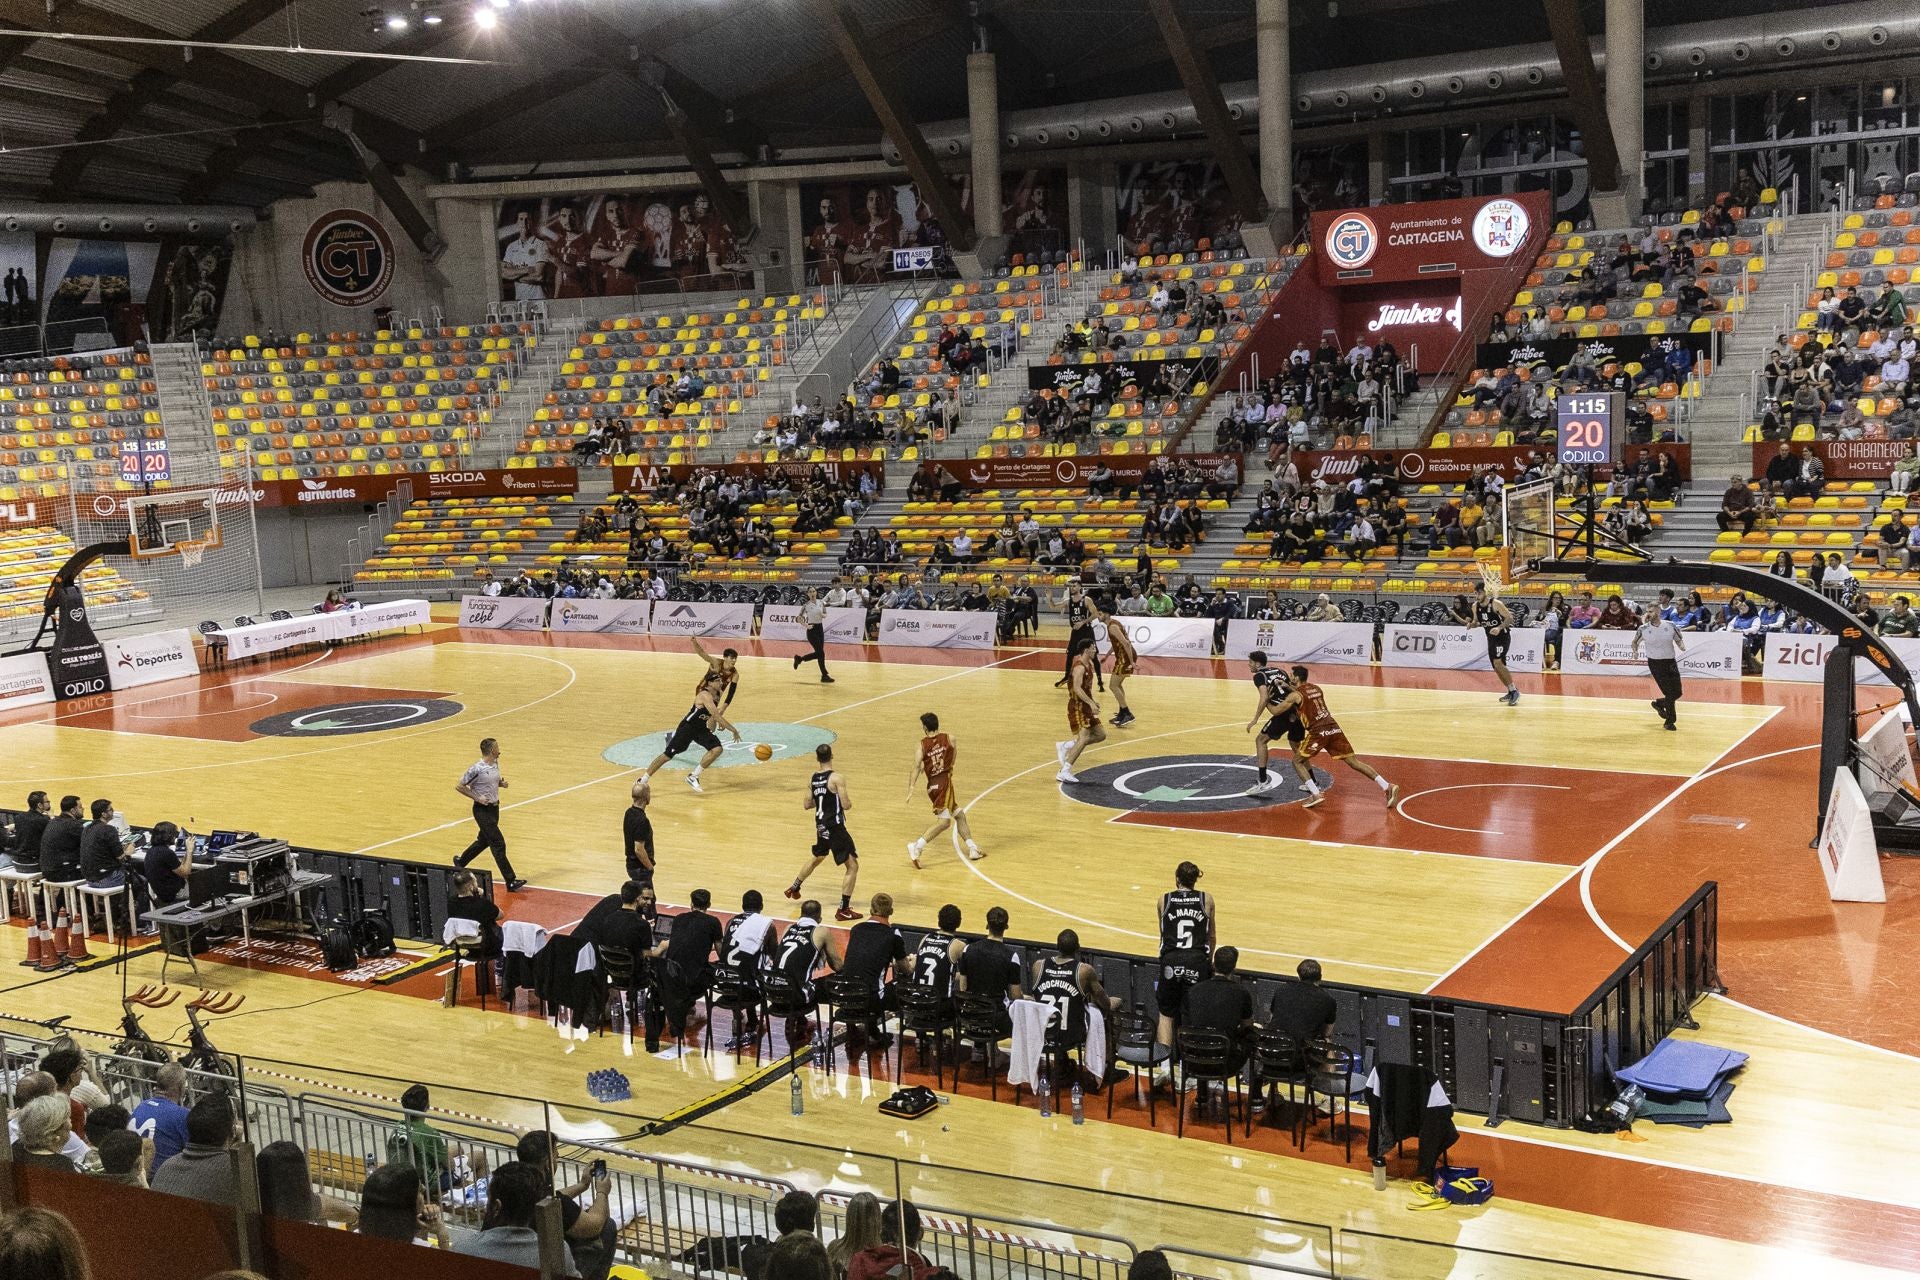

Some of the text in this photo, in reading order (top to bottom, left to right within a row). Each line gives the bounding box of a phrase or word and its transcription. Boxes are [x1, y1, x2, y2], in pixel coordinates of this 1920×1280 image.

[1390, 216, 1462, 231] Ayuntamiento de
[1336, 230, 1367, 252] CT
[1388, 230, 1465, 246] CARTAGENA
[321, 240, 376, 278] CT
[1368, 302, 1442, 332] Jimbee
[1508, 345, 1545, 362] Jimbee
[1569, 399, 1606, 414] 1:15
[1565, 421, 1604, 448] 20
[122, 441, 138, 450] 1:15
[146, 440, 166, 450] 1:15
[1828, 442, 1846, 458] LOS
[145, 454, 166, 471] 20
[1563, 450, 1605, 462] ODILO
[122, 455, 138, 472] 20
[1022, 463, 1051, 472] Cartagena
[1311, 455, 1358, 479] Jimb
[1429, 463, 1459, 471] REGIÓN
[1460, 463, 1471, 471] DE
[1849, 461, 1885, 470] HOTEL
[145, 472, 168, 480] ODILO
[1116, 469, 1143, 477] MURCIA
[203, 487, 265, 508] Jimbee
[298, 488, 356, 502] agriverdes
[563, 609, 599, 620] CARTAGENA
[770, 614, 789, 623] CASA
[617, 619, 629, 627] Palco
[658, 617, 706, 630] inmohogares
[897, 621, 920, 629] CAESA
[283, 628, 307, 640] Cartagena
[830, 629, 843, 637] Palco
[1438, 632, 1473, 642] woods
[1169, 641, 1186, 649] Palco
[1395, 635, 1436, 651] CTD
[1323, 647, 1342, 655] Palco
[135, 651, 183, 668] Deportes
[1511, 654, 1525, 662] VIP
[1684, 660, 1721, 669] Palco VIP
[0, 677, 44, 691] artagena
[65, 679, 104, 697] ODILO
[1168, 908, 1205, 922] A. MARTÍN
[1176, 919, 1195, 949] 5
[779, 941, 798, 969] 7
[919, 946, 946, 959] CABRERA
[919, 957, 937, 986] 3
[1174, 968, 1199, 978] CAESA
[1038, 979, 1079, 997] UGOCHUKWU
[1522, 1043, 1528, 1051] 3
